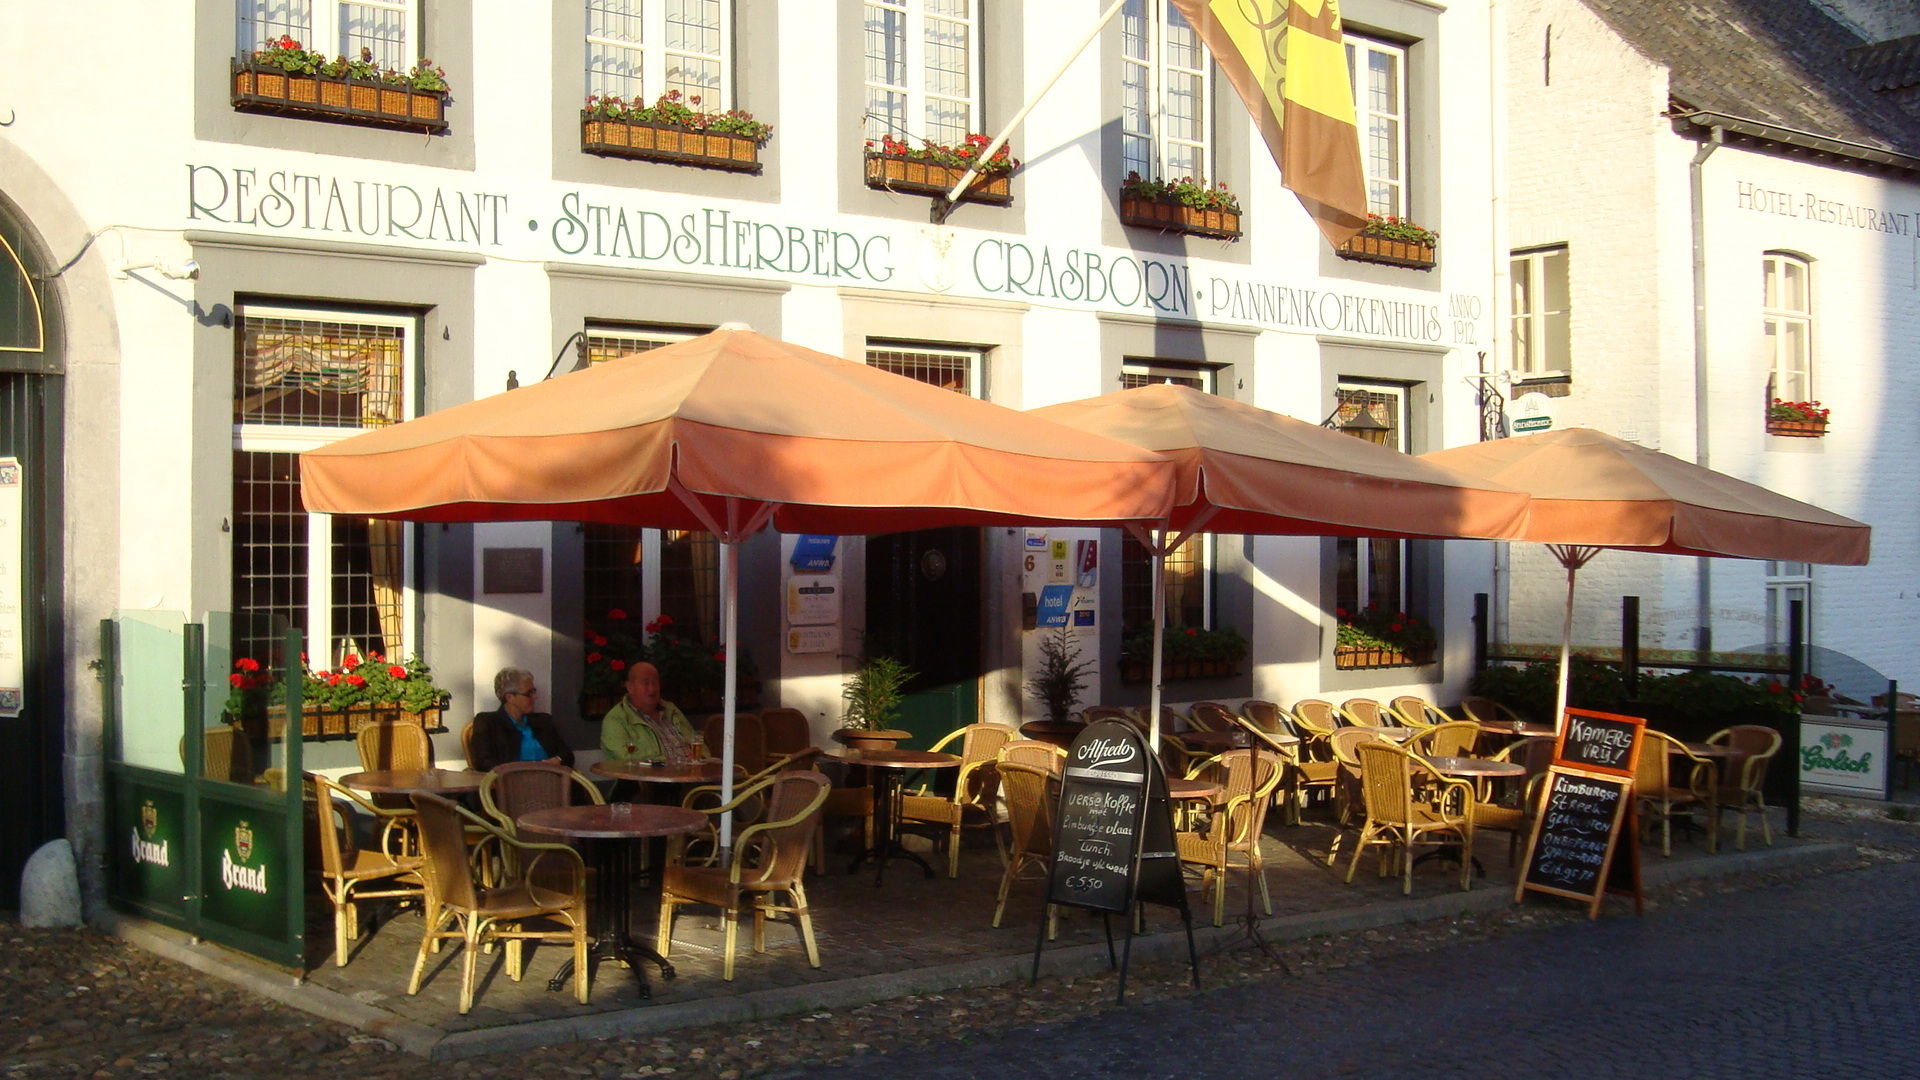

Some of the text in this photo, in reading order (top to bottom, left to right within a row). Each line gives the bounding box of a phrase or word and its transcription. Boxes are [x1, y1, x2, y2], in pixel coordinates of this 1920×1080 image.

[185, 163, 1441, 342] RESTAURANT STADSHERBERG CRASBORN PANNENKOEKENHUIS
[1448, 292, 1482, 320] ANNO
[1024, 554, 1035, 572] 6
[1044, 596, 1063, 608] hotel
[1046, 615, 1067, 624] ANWB
[1077, 738, 1136, 766] Alfredo
[1800, 745, 1872, 773] Grolsch
[131, 825, 170, 867] Brand
[222, 847, 267, 894] Brand
[1105, 861, 1130, 877] week
